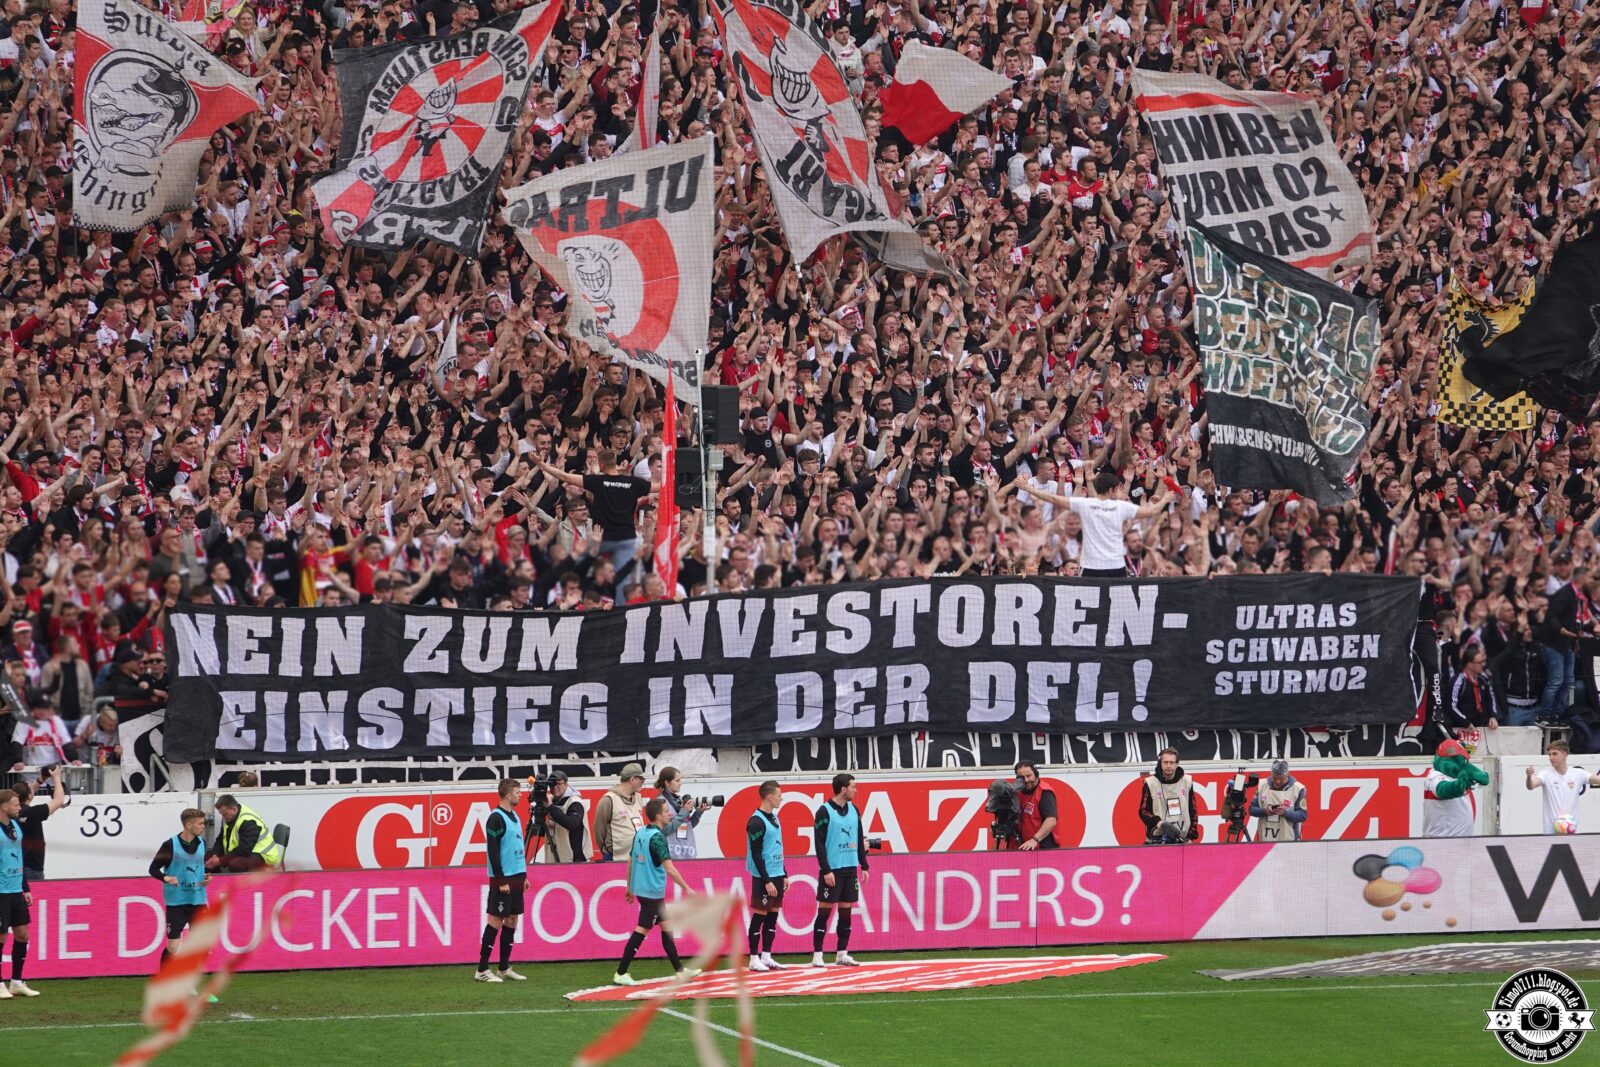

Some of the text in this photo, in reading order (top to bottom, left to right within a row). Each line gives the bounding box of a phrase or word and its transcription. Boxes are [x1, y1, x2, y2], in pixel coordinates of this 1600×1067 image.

[170, 583, 1189, 677] NEIN ZUM INVESTOREN-
[1236, 602, 1357, 631] ULTRAS
[1206, 634, 1381, 664] SCHWABEN
[1215, 665, 1367, 696] STURM02
[1432, 673, 1441, 705] adidas
[215, 682, 609, 752] EINSTIEG
[648, 673, 734, 738] IN
[775, 663, 931, 734] DER
[967, 658, 1153, 723] DFL!
[80, 805, 123, 837] 33
[1265, 827, 1280, 838] TV
[118, 885, 452, 958] DUCKEN
